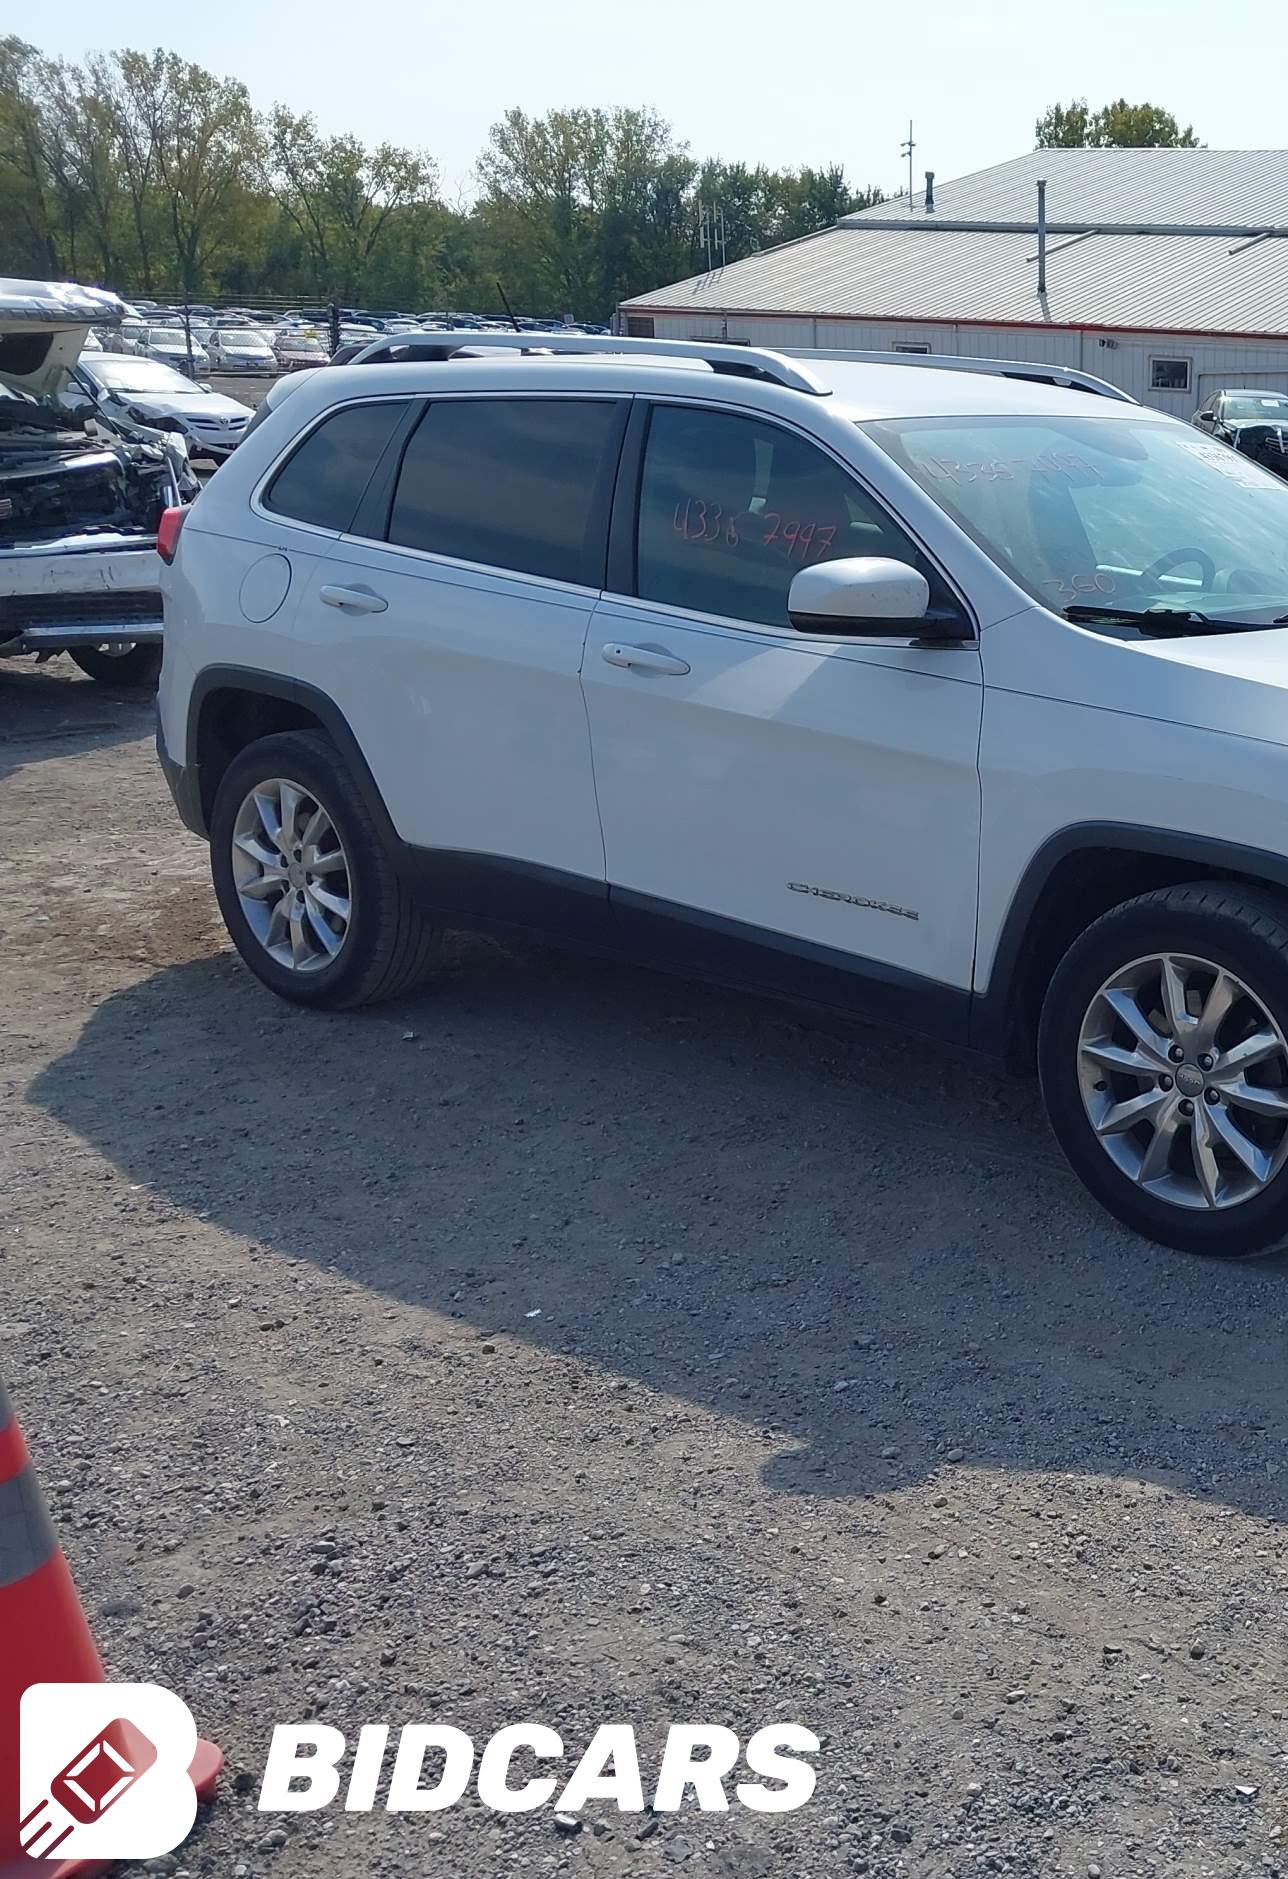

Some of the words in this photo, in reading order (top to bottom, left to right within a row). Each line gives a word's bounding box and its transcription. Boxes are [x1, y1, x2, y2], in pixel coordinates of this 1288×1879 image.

[762, 513, 838, 560] 7997
[1039, 573, 1117, 603] 360
[785, 881, 920, 921] CHEROKEE
